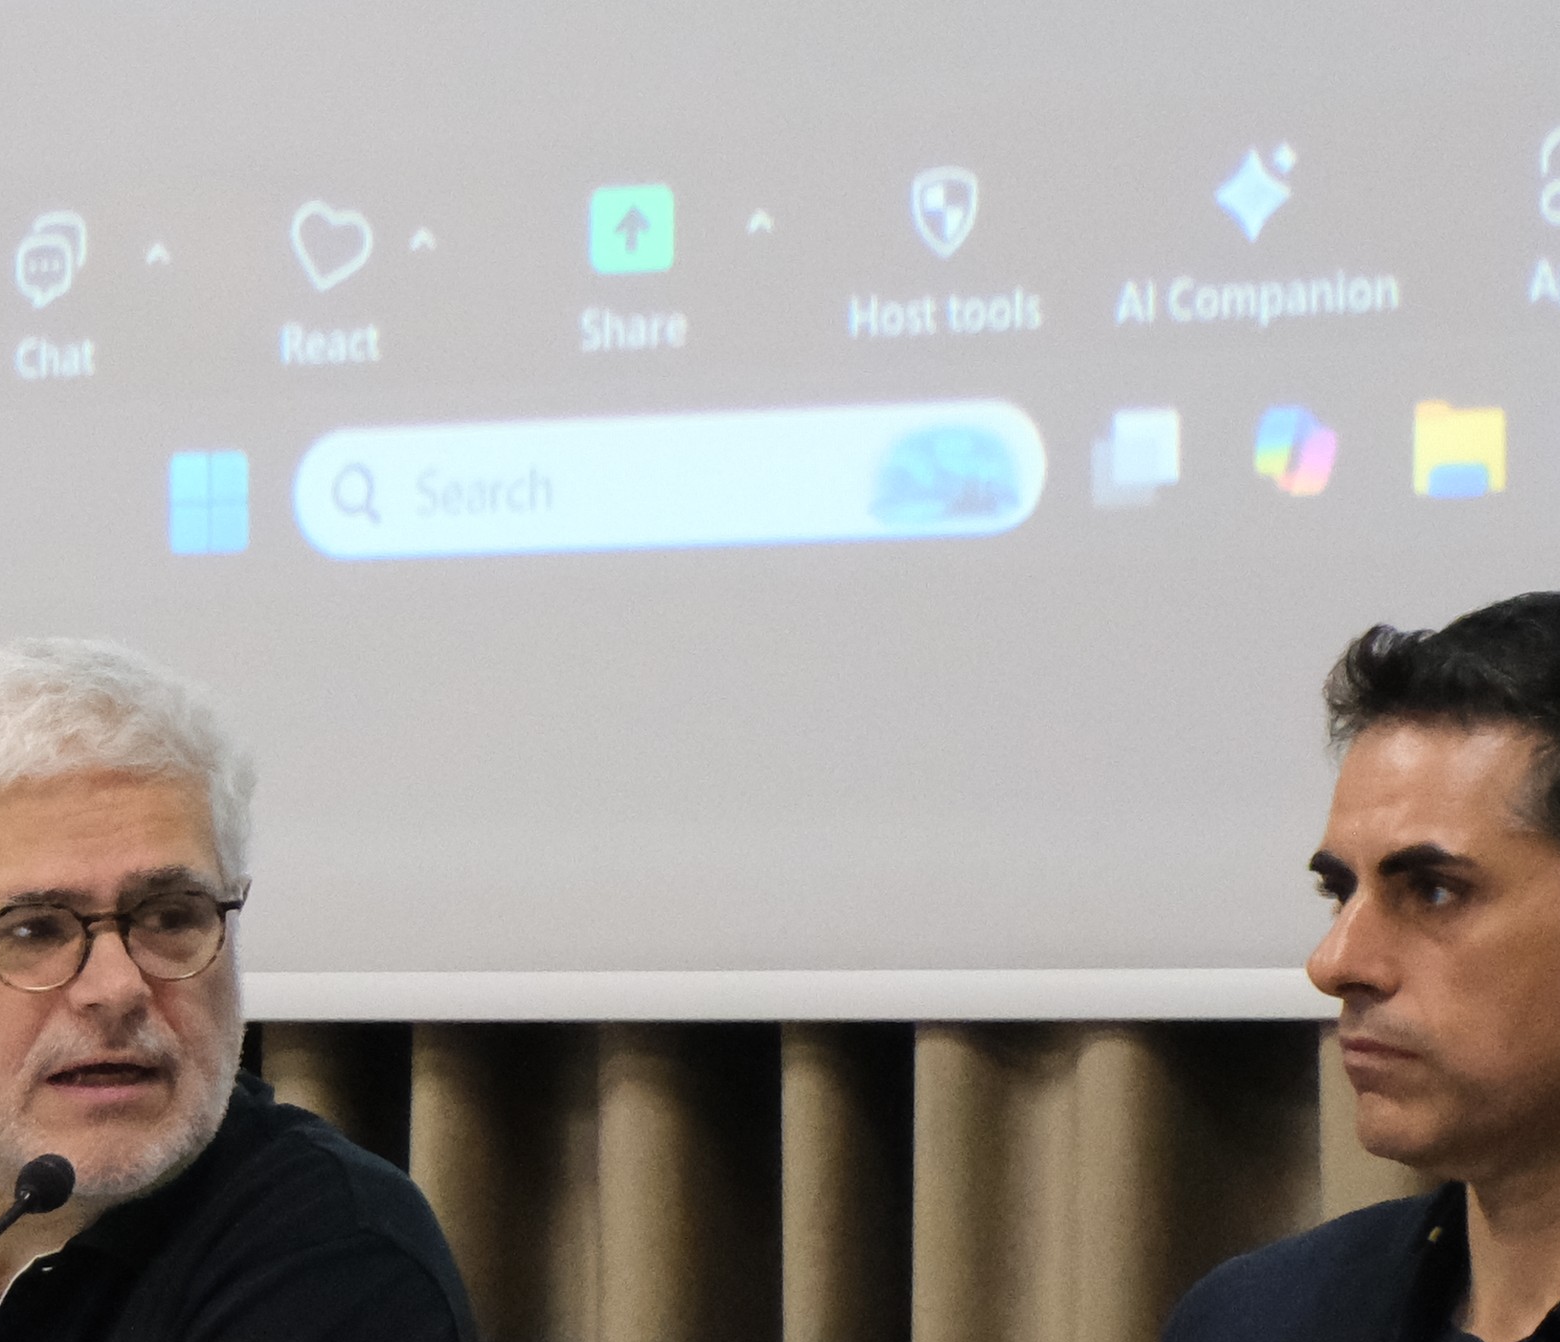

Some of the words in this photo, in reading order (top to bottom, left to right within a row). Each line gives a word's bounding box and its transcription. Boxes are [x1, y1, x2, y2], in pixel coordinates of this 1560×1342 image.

[847, 296, 936, 338] Host
[947, 288, 1042, 332] tools
[1115, 281, 1156, 325] AI
[1167, 271, 1399, 327] Companion
[280, 323, 380, 366] React
[580, 308, 687, 352] Share
[15, 337, 94, 380] Chat
[414, 467, 554, 517] Search
